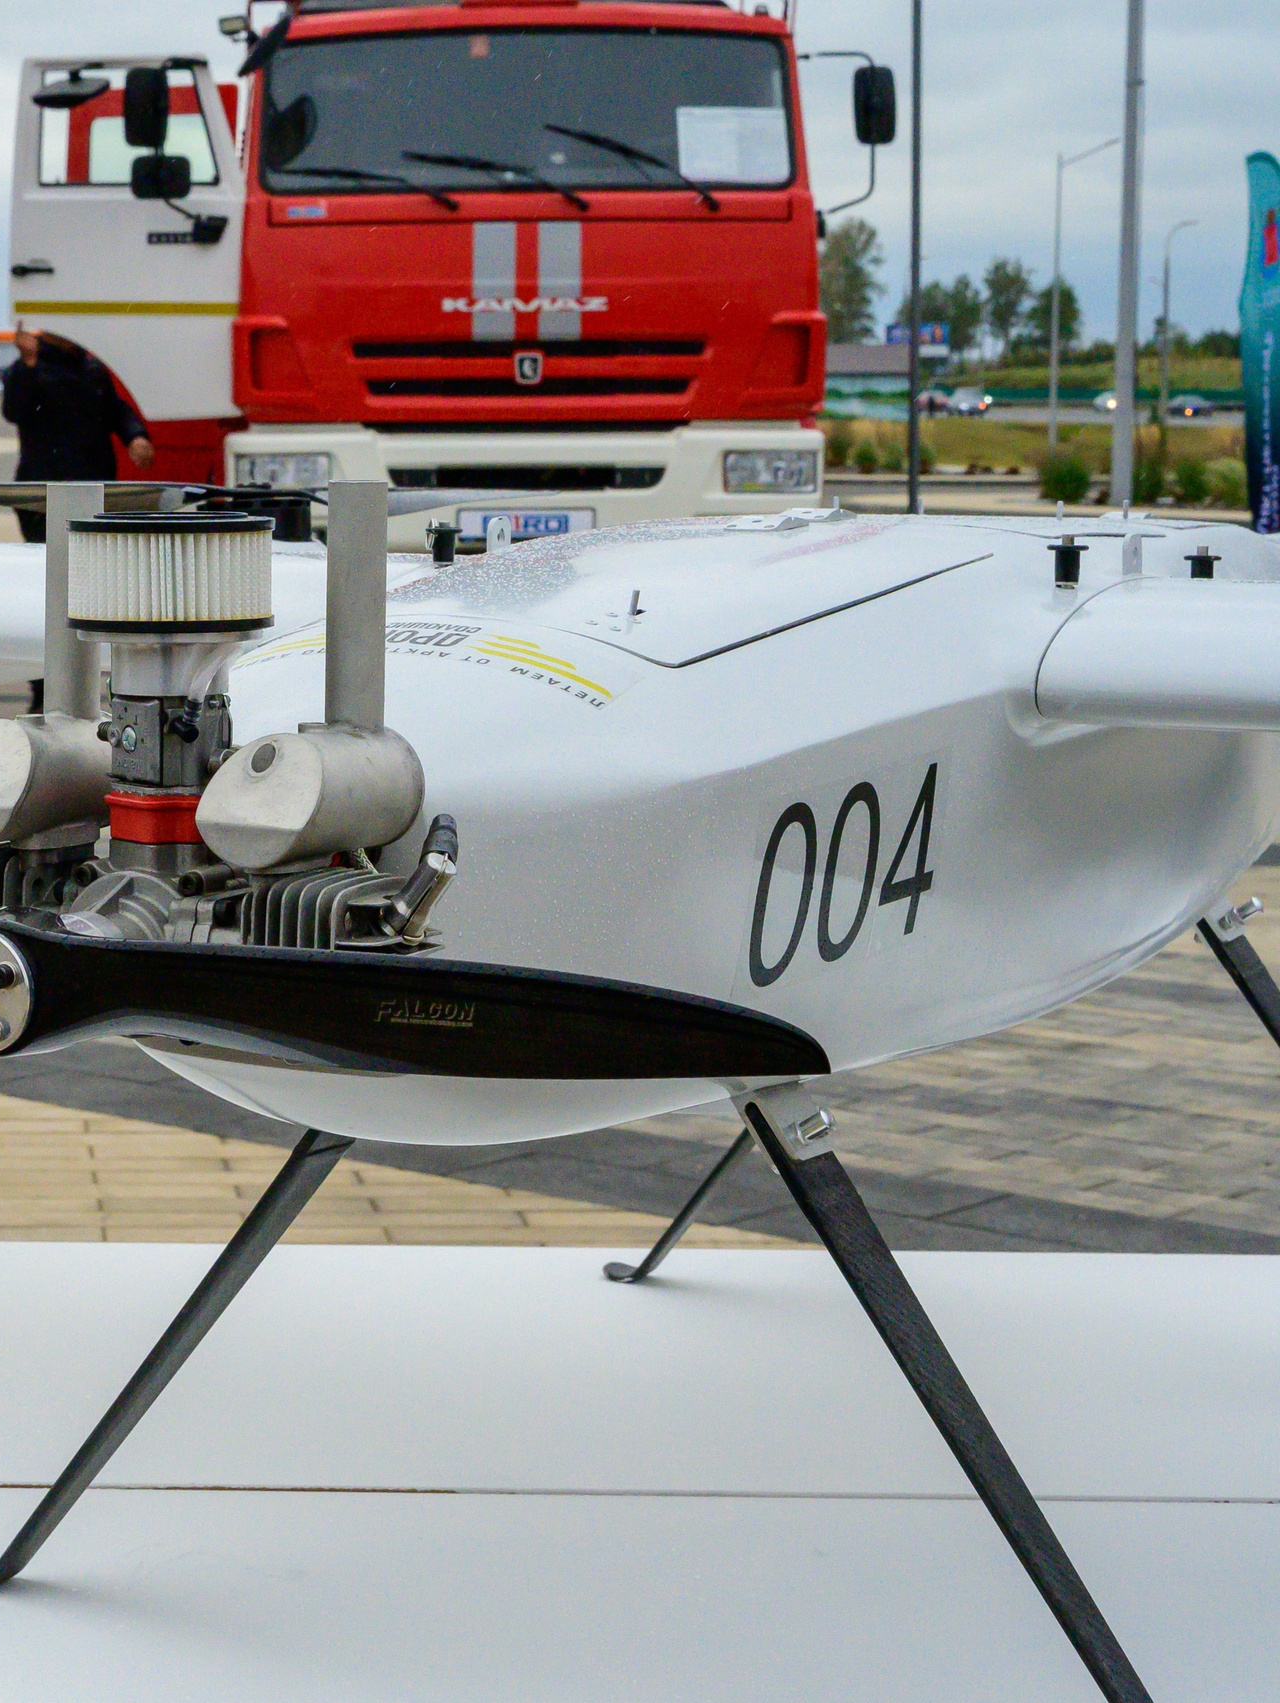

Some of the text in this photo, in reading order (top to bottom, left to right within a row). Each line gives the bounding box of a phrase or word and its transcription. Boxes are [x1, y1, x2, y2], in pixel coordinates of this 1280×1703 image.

[384, 647, 452, 659] АРКТ
[460, 655, 491, 666] ОТ
[510, 666, 606, 708] ЛЕТАЕМ
[749, 762, 938, 987] 004
[373, 1000, 476, 1021] FALCON
